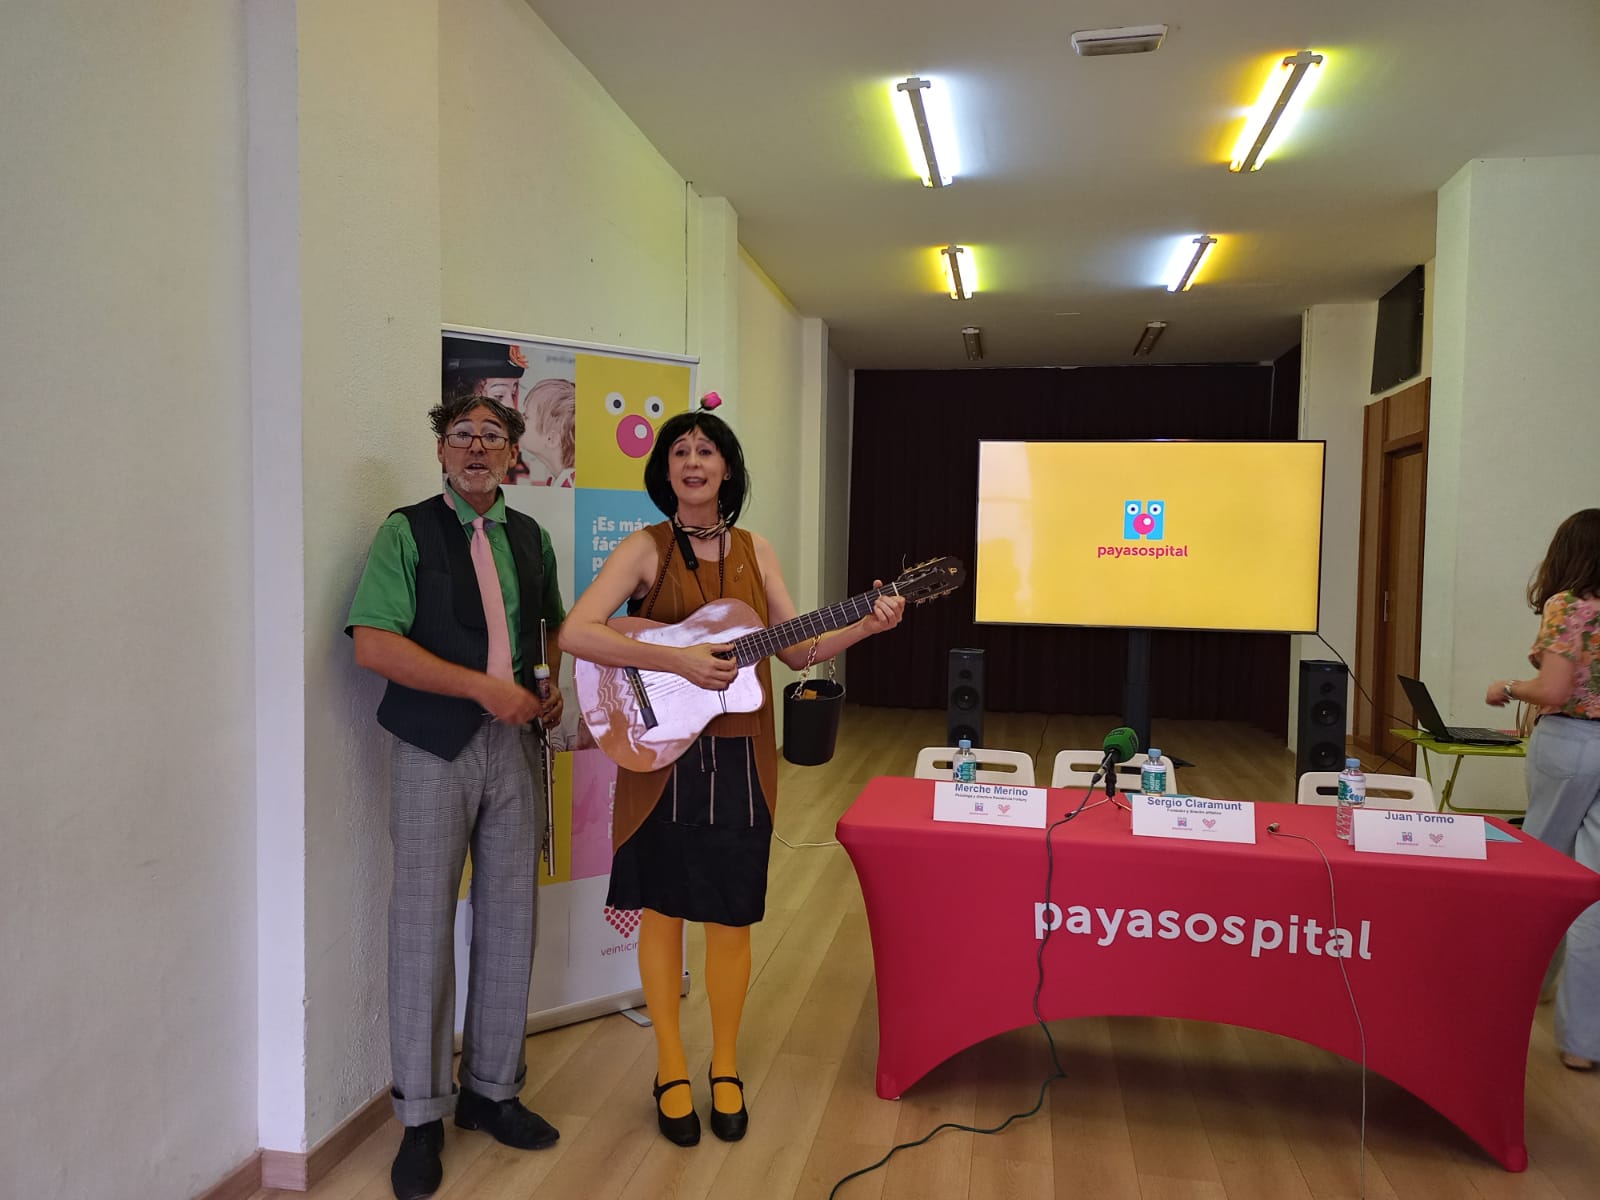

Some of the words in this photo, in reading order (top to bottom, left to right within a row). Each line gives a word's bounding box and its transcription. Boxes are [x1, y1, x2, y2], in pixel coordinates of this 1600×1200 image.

[592, 516, 615, 535] ¡Es
[1098, 545, 1188, 559] payasospital
[955, 783, 991, 794] Merche
[994, 786, 1029, 797] Merino
[1147, 796, 1182, 808] Sergio
[1185, 798, 1242, 811] Claramunt
[1384, 811, 1413, 822] Juan
[1416, 812, 1455, 824] Tormo
[1034, 901, 1372, 960] payasospital
